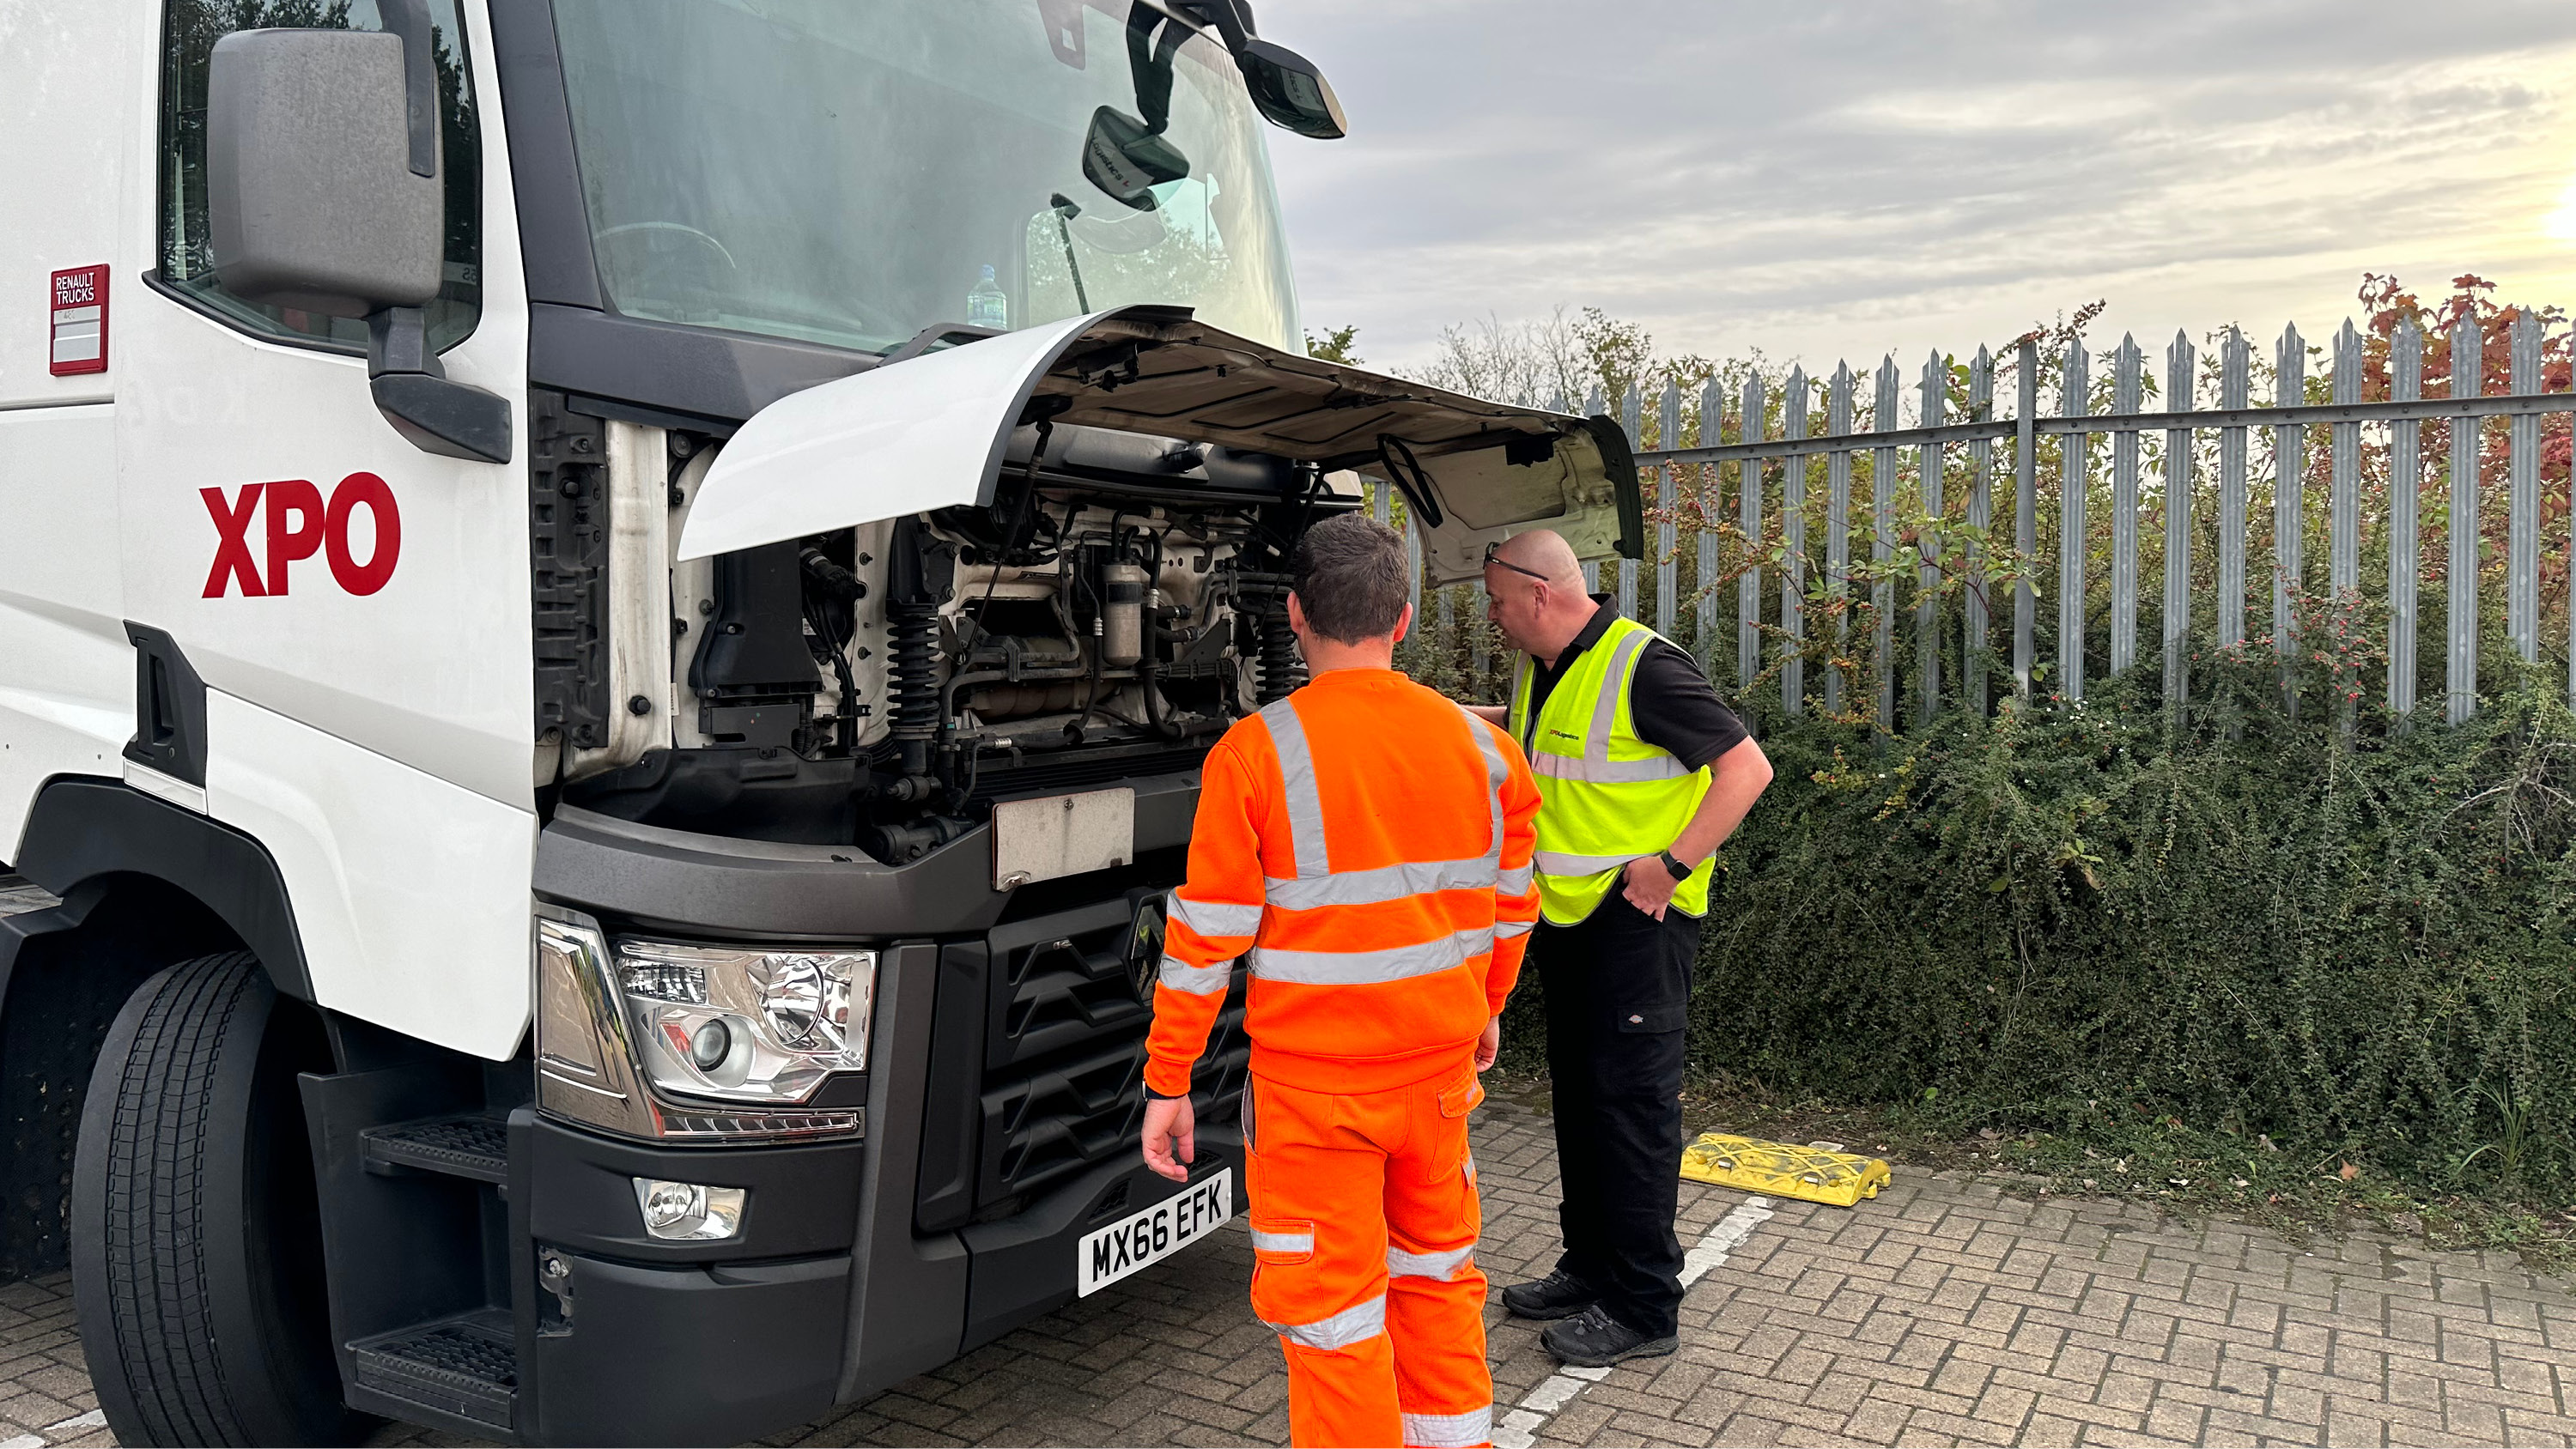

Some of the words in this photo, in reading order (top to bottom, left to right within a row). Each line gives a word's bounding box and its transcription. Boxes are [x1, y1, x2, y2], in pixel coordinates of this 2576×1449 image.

[56, 272, 94, 291] RENAULT
[56, 287, 94, 305] TRUCKS
[199, 471, 401, 599] XPO
[1092, 1209, 1169, 1283] MX66
[1176, 1179, 1222, 1242] EFK
